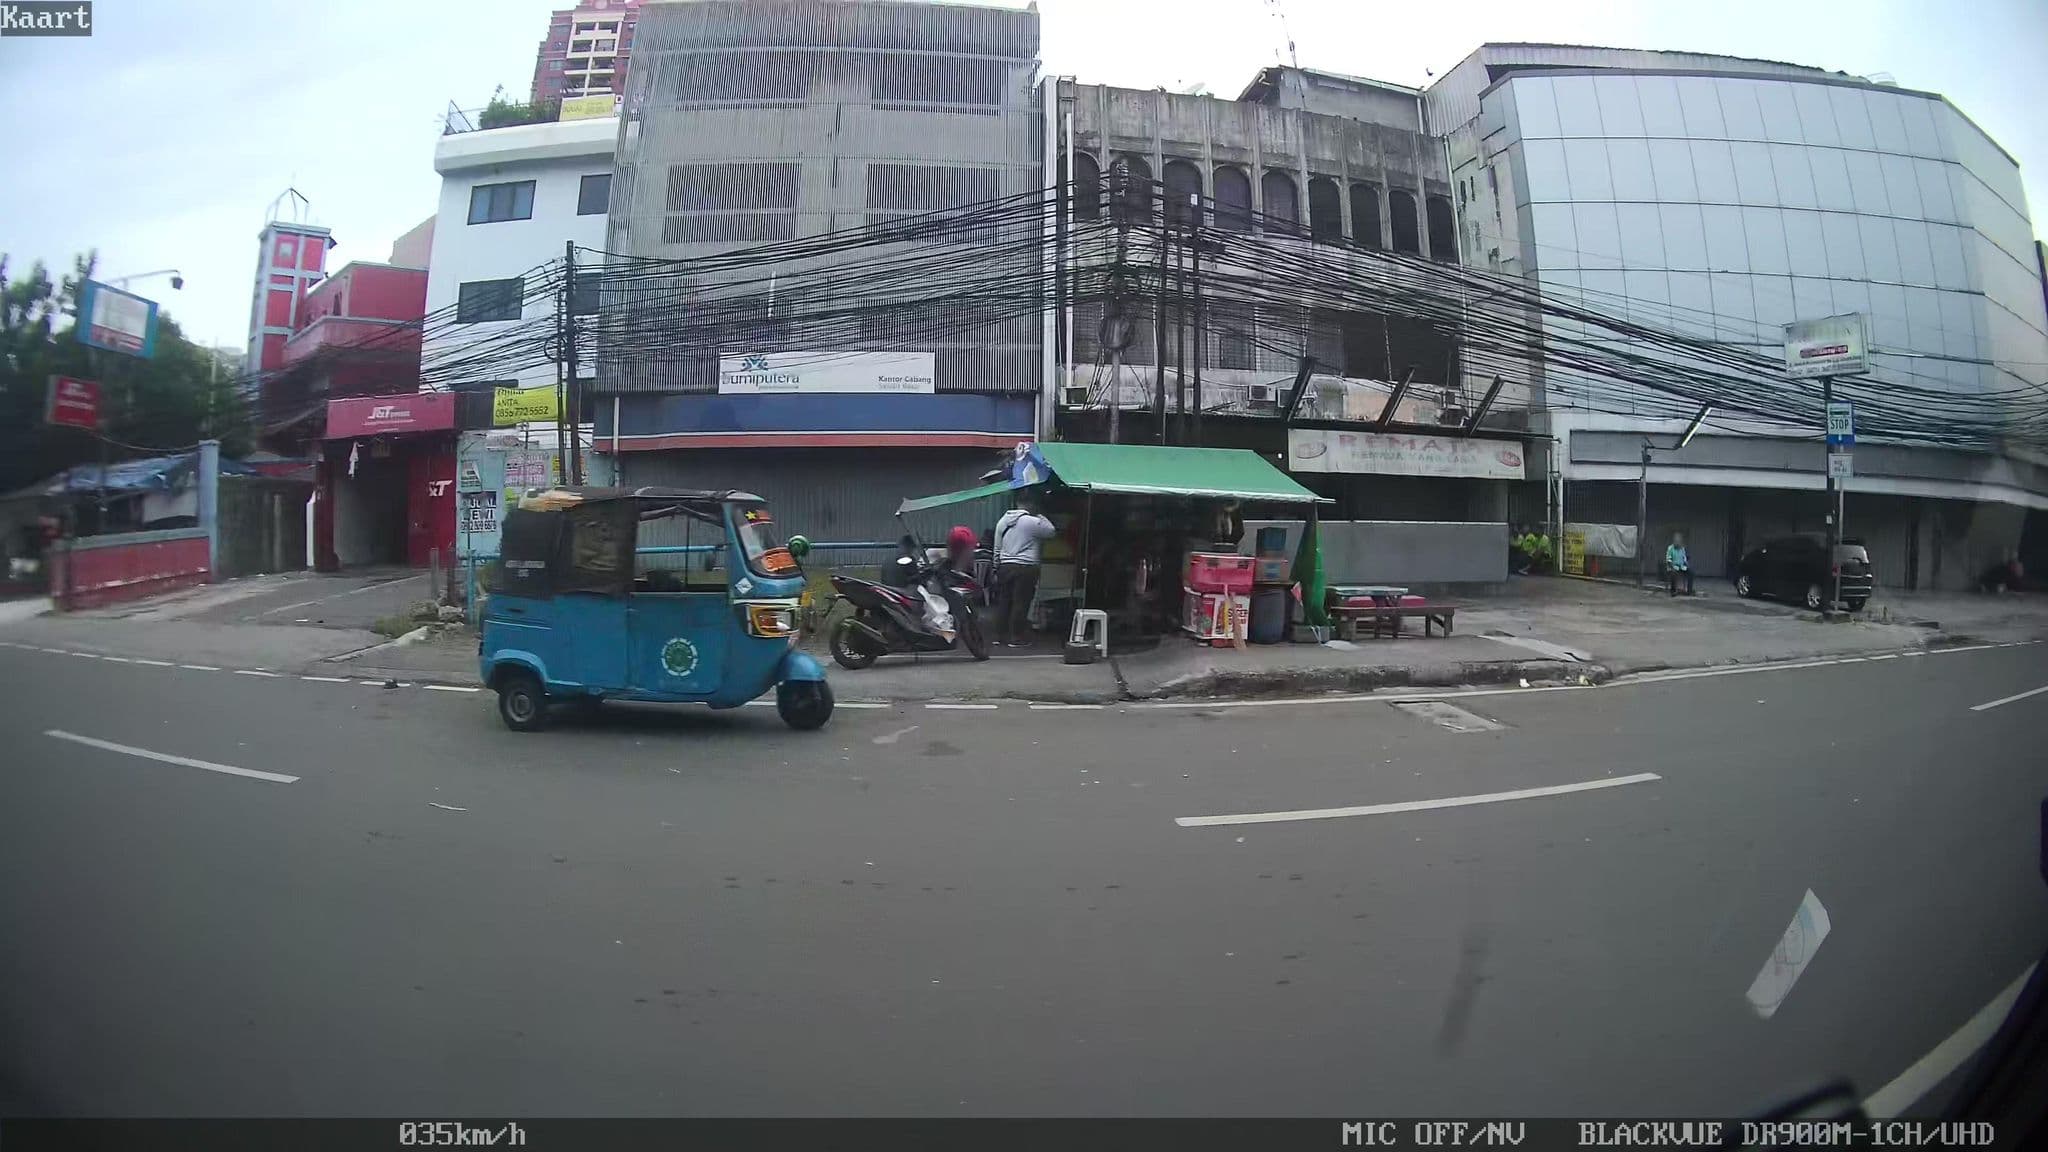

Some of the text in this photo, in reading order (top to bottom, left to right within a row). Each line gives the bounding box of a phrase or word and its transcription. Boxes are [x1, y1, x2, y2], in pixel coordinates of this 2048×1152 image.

[878, 375, 932, 385] Kantor Cabang
[1830, 418, 1849, 431] STOP
